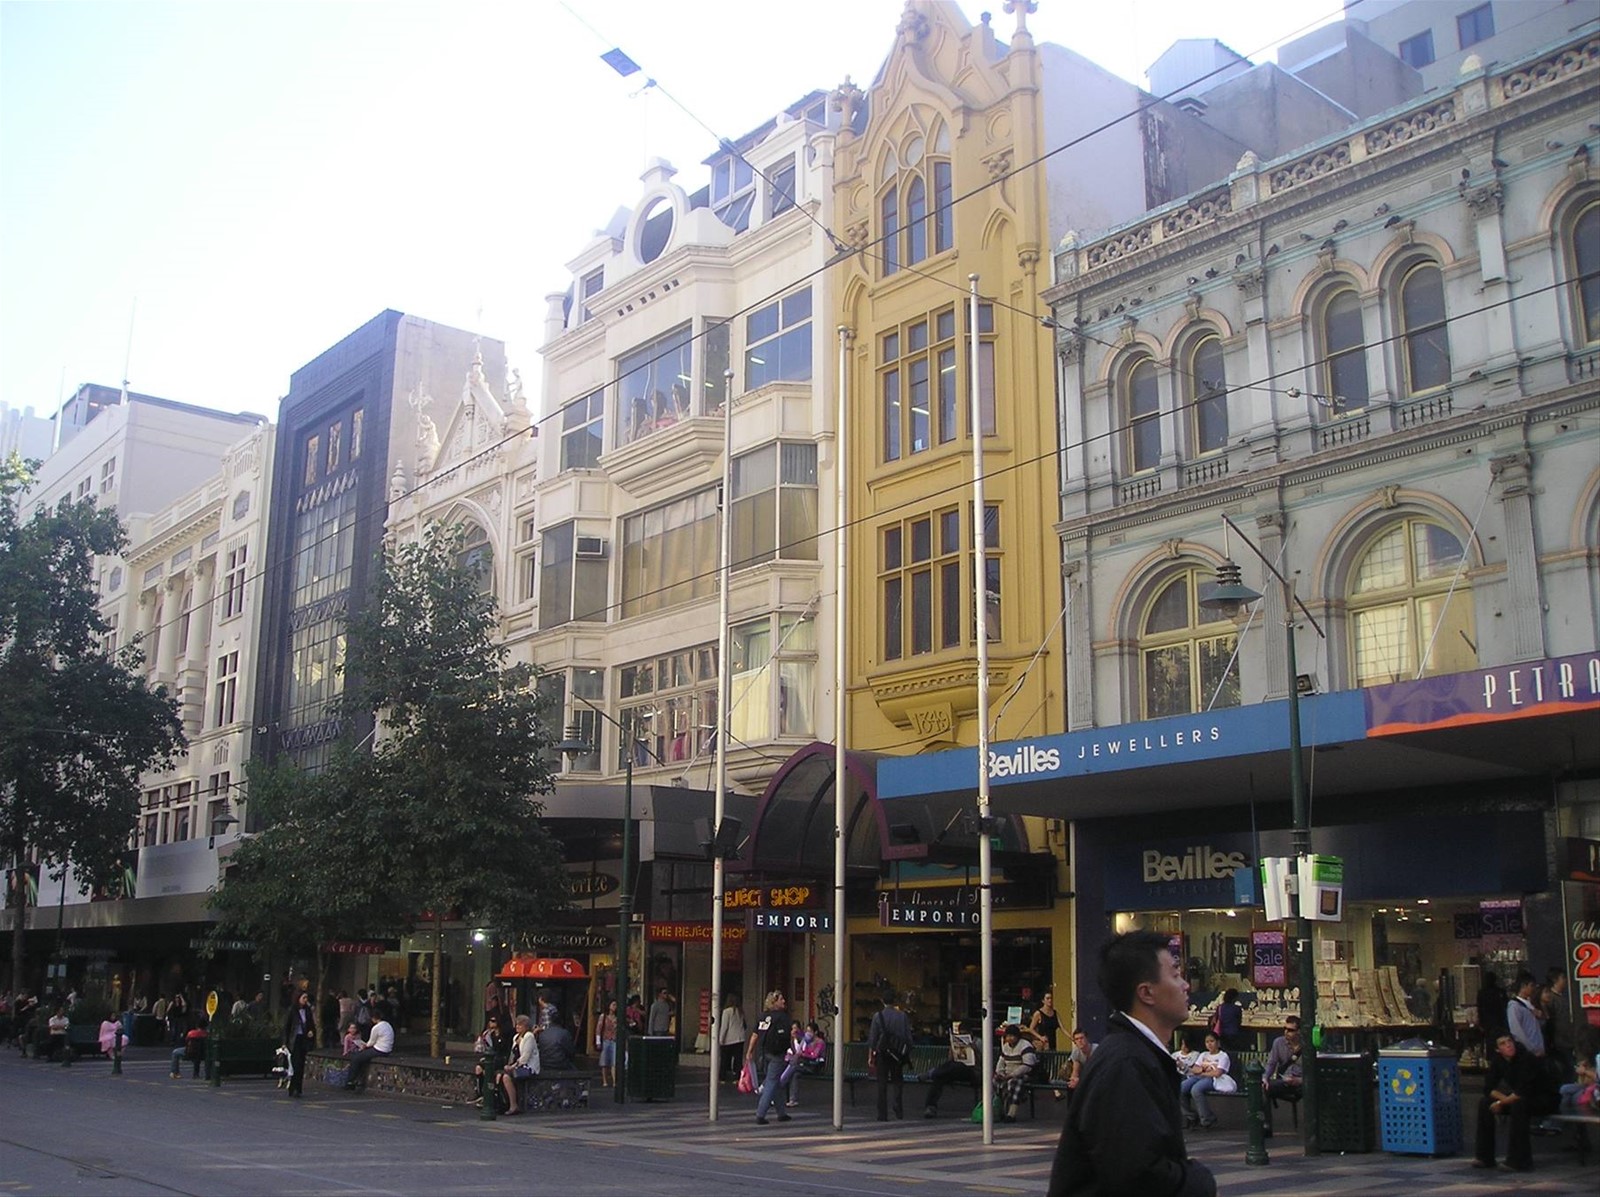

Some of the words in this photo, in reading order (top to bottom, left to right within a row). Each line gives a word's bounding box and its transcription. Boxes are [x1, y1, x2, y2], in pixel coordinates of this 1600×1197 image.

[1078, 727, 1221, 759] JEWELLERS
[1142, 846, 1246, 883] Bevilles
[724, 888, 763, 908] EJECT
[770, 887, 809, 906] SHOP
[756, 914, 835, 929] EMPORI
[892, 909, 980, 924] EMPORIO
[1482, 914, 1520, 934] Sale
[651, 925, 671, 937] THE
[1456, 919, 1481, 938] Sal
[1254, 949, 1282, 966] Sale
